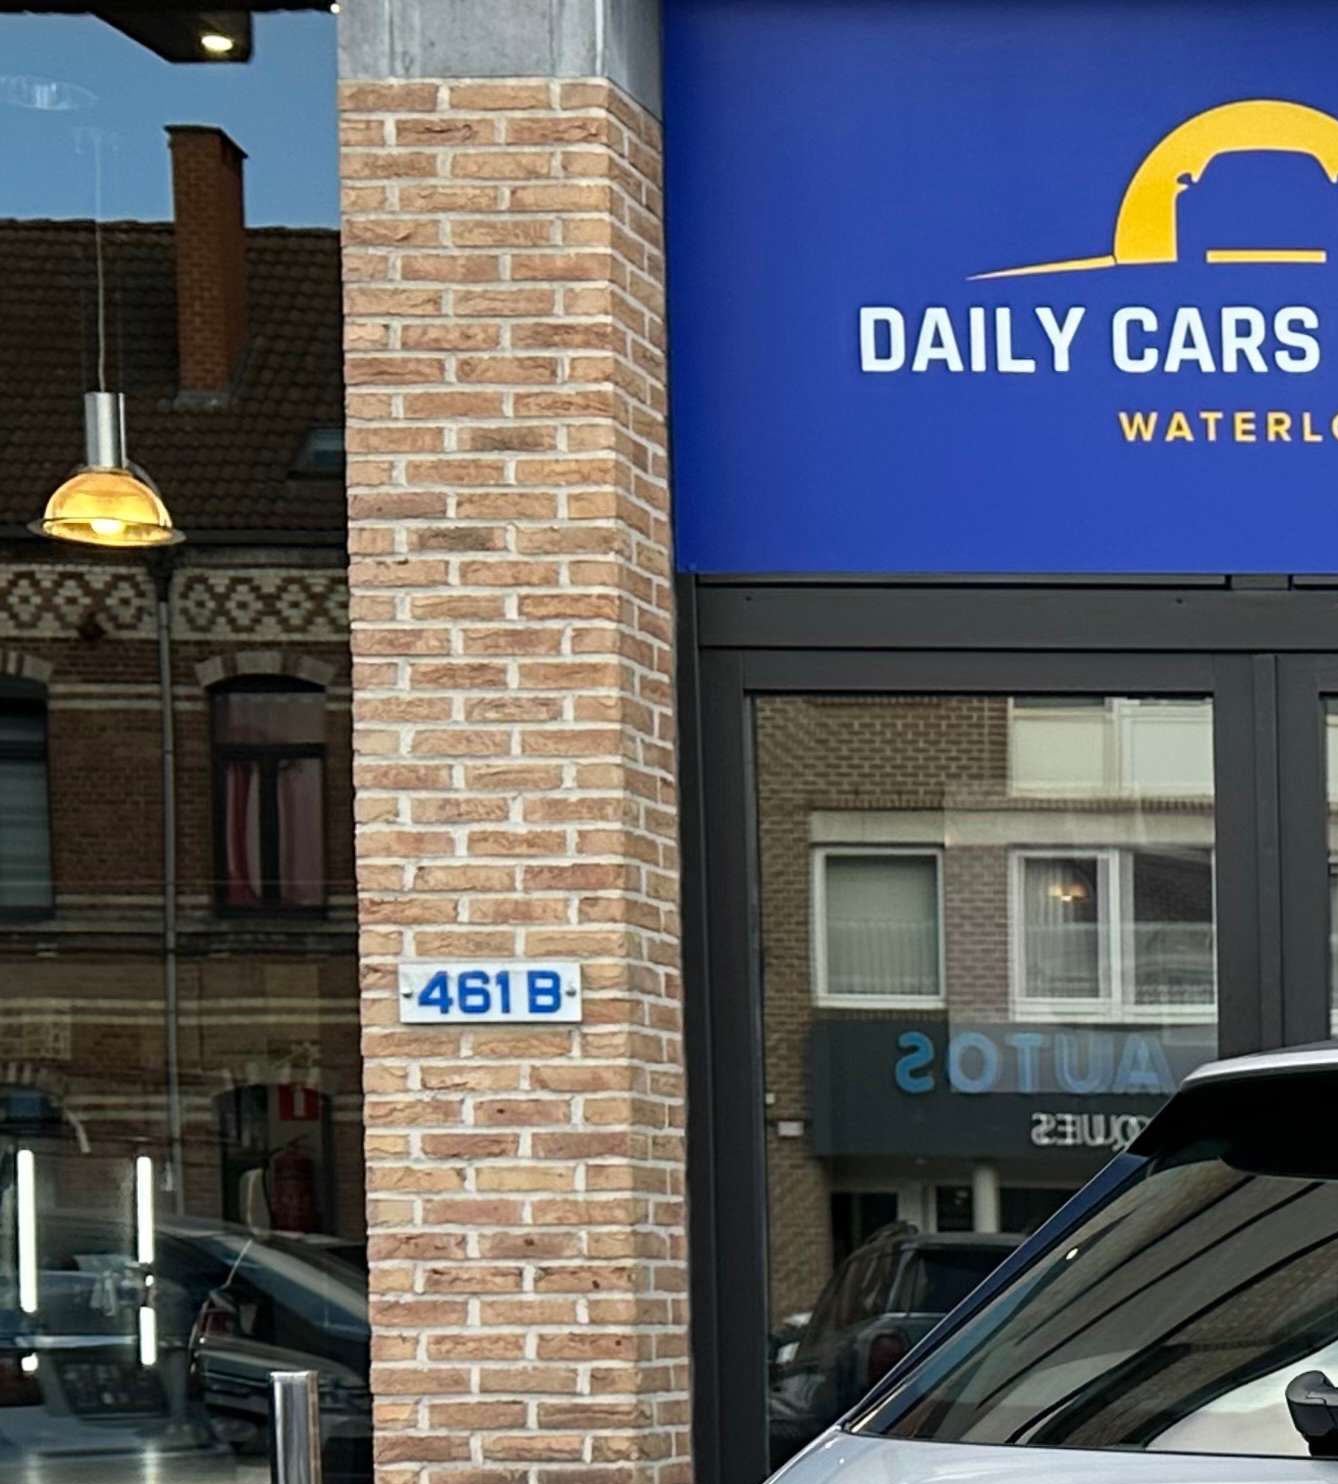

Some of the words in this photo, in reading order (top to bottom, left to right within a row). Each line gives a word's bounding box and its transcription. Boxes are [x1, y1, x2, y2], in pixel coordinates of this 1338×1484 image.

[858, 306, 1086, 374] DAILY
[1111, 306, 1321, 374] CARS
[417, 969, 511, 1015] 461
[527, 969, 563, 1014] B
